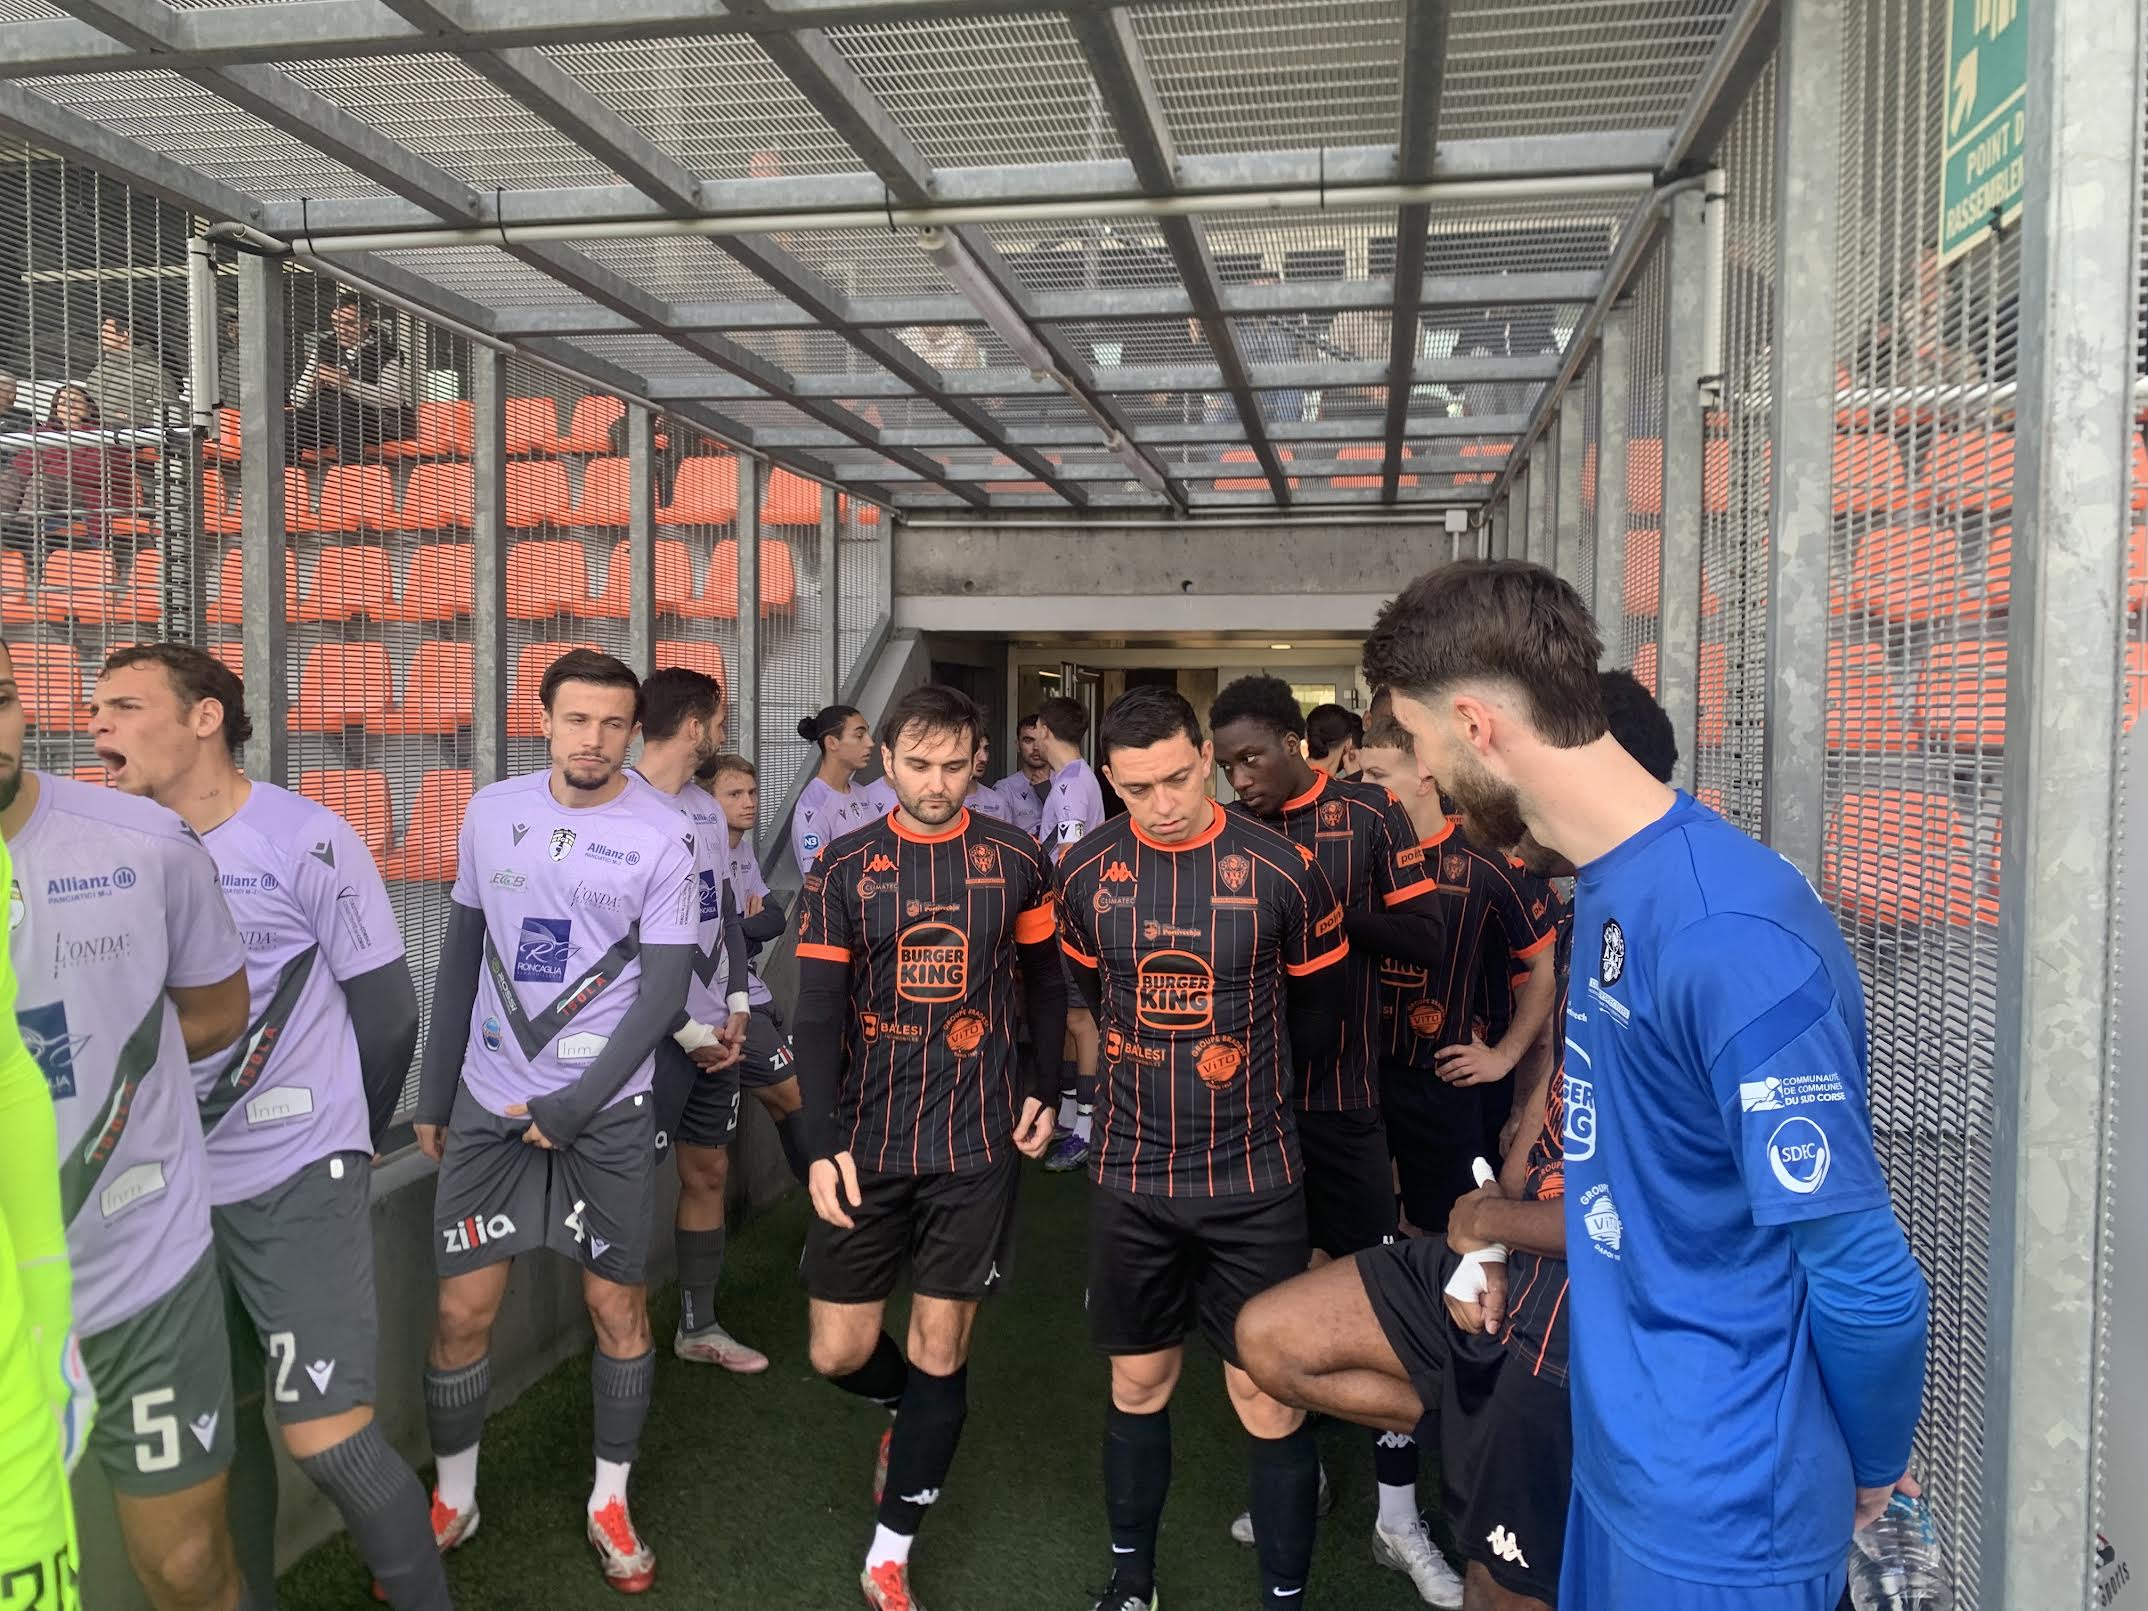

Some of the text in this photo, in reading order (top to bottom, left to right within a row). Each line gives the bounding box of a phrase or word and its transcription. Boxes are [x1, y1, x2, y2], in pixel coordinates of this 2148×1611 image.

[1966, 110, 2024, 185] POINT D
[587, 842, 625, 861] Allianz
[804, 837, 817, 847] N3
[48, 876, 111, 895] Allianz
[221, 875, 258, 888] llianz
[1100, 896, 1136, 905] CLIMATEC
[1319, 911, 1342, 932] poin
[901, 949, 964, 963] BURGER
[517, 961, 562, 974] RONCAGLIA
[901, 965, 964, 985] KING
[1142, 976, 1210, 990] BURGER
[1140, 990, 1209, 1010] KING
[880, 1022, 922, 1036] BALESI
[1124, 1042, 1166, 1061] BALESI
[1191, 1036, 1220, 1057] GROUPE
[1782, 1072, 1840, 1086] COMMUNAUTÉ
[1784, 1082, 1843, 1095] DE COMMUNES
[1563, 1078, 1594, 1109] GER
[1785, 1091, 1847, 1106] DU SUD CORSE
[1781, 1143, 1816, 1162] SDEC
[443, 1214, 516, 1253] zilia
[269, 1331, 299, 1403] 2
[132, 1387, 180, 1473] 5
